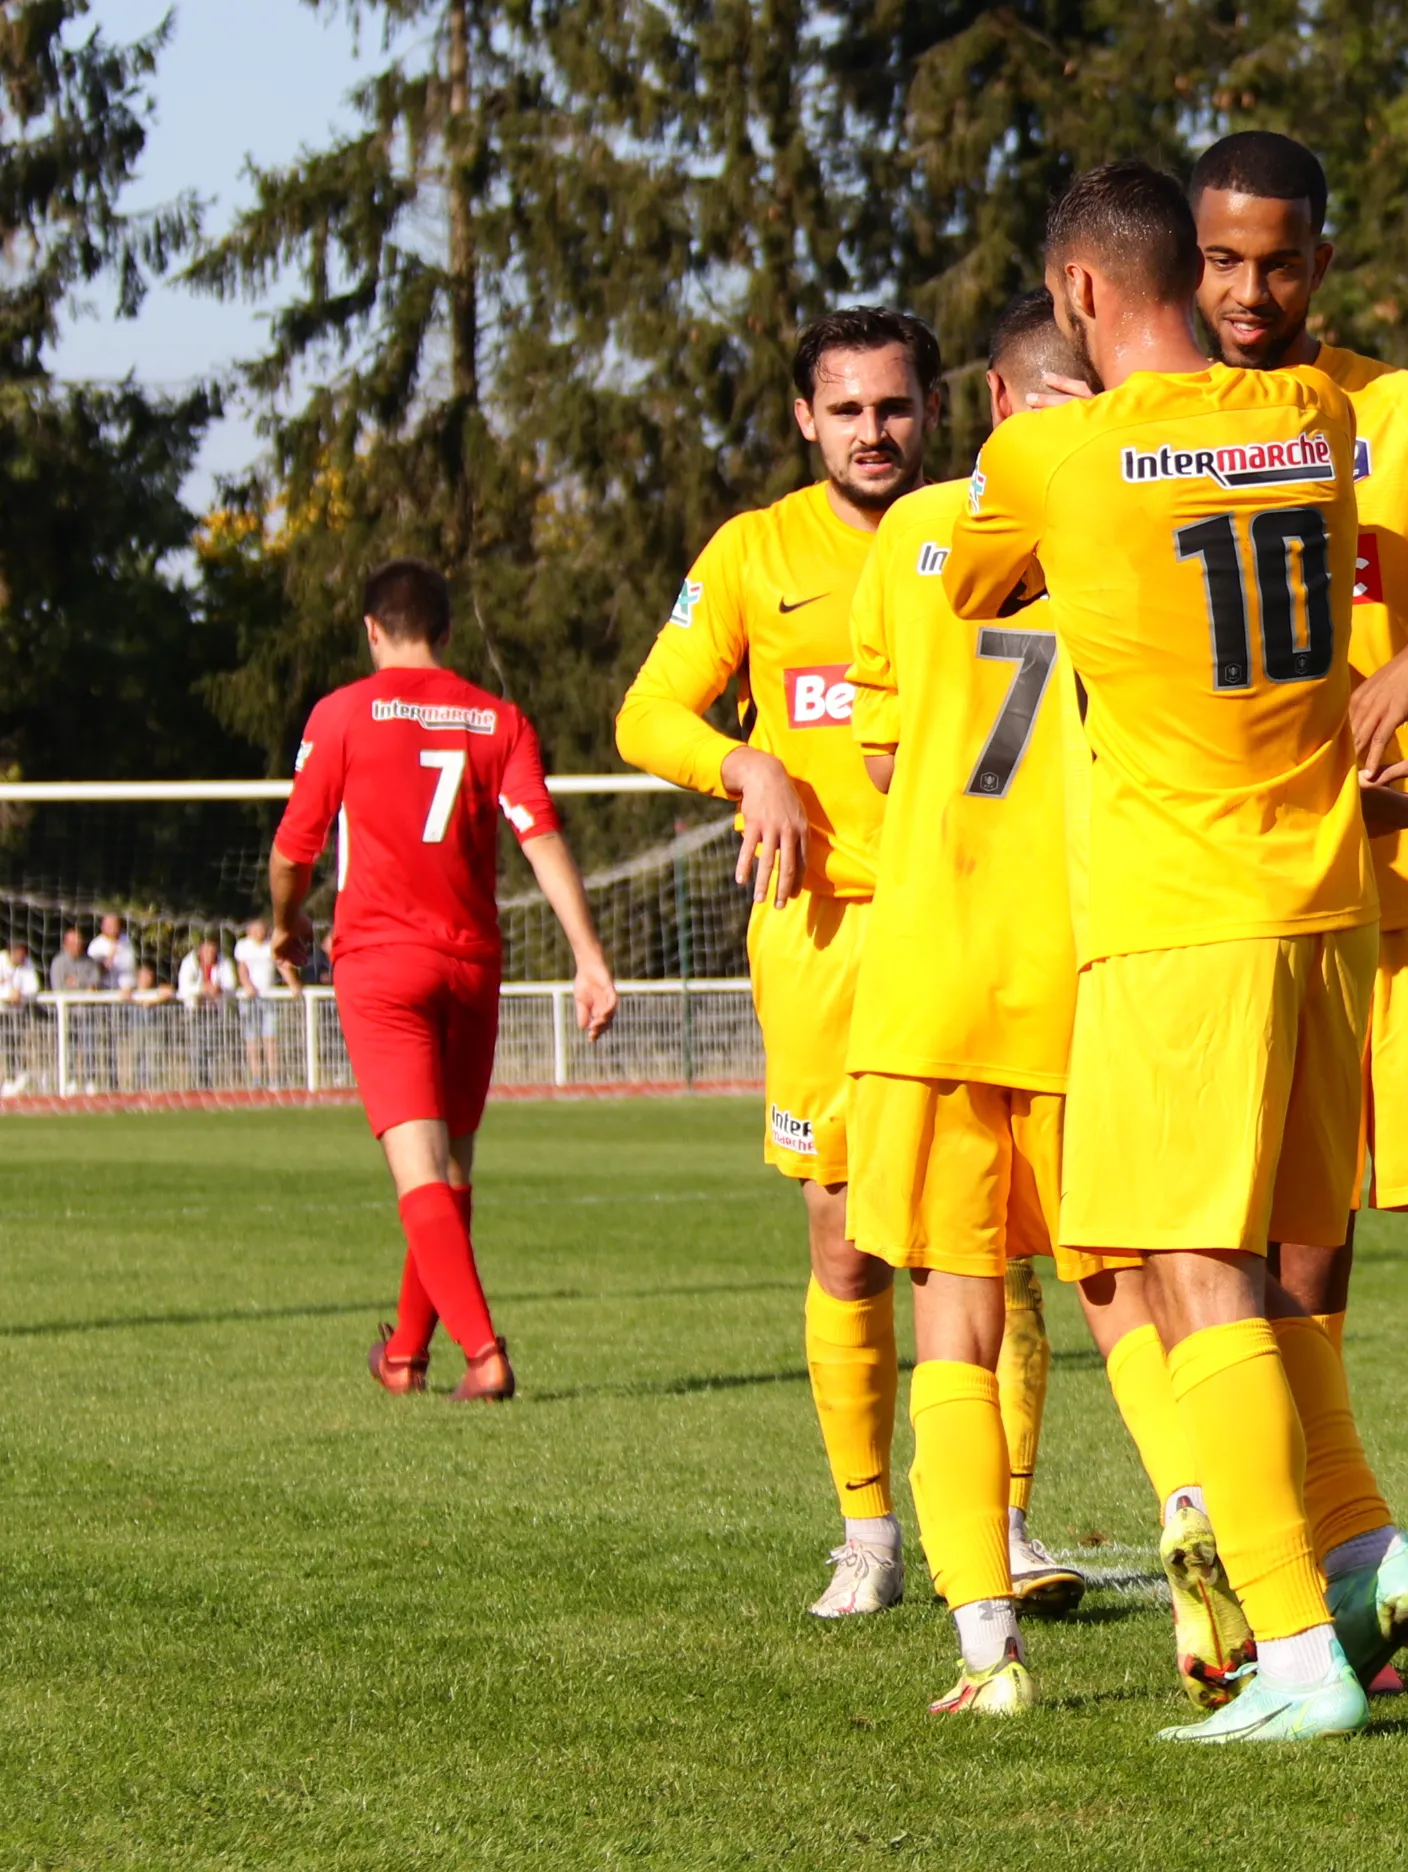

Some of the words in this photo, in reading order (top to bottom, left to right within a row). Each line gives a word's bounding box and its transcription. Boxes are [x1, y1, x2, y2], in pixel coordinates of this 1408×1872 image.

[1173, 506, 1334, 690] 10
[419, 750, 465, 843] 7
[963, 627, 1058, 799] 7
